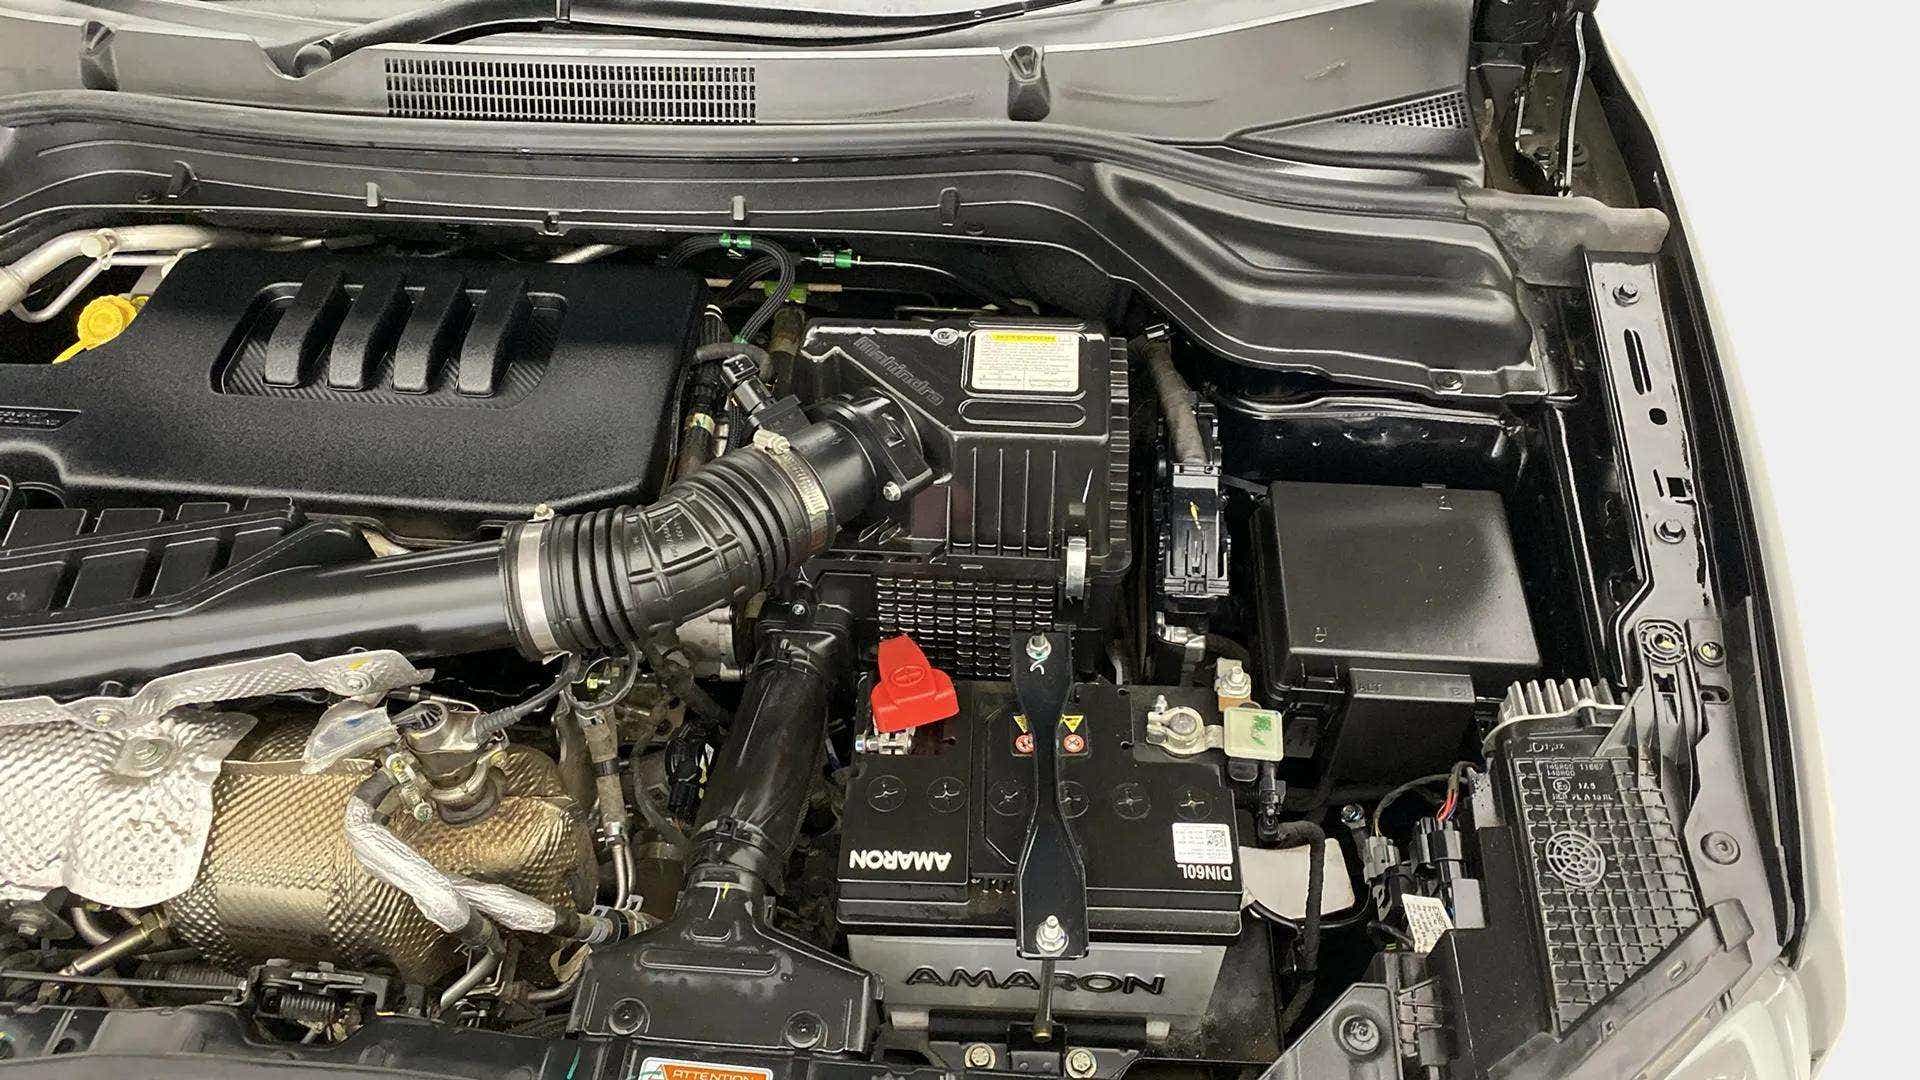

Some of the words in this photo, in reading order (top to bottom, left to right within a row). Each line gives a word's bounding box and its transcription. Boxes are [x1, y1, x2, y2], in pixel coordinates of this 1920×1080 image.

[853, 336, 944, 406] Mahindra
[849, 849, 952, 871] AMARON
[1177, 864, 1232, 880] DIN60L
